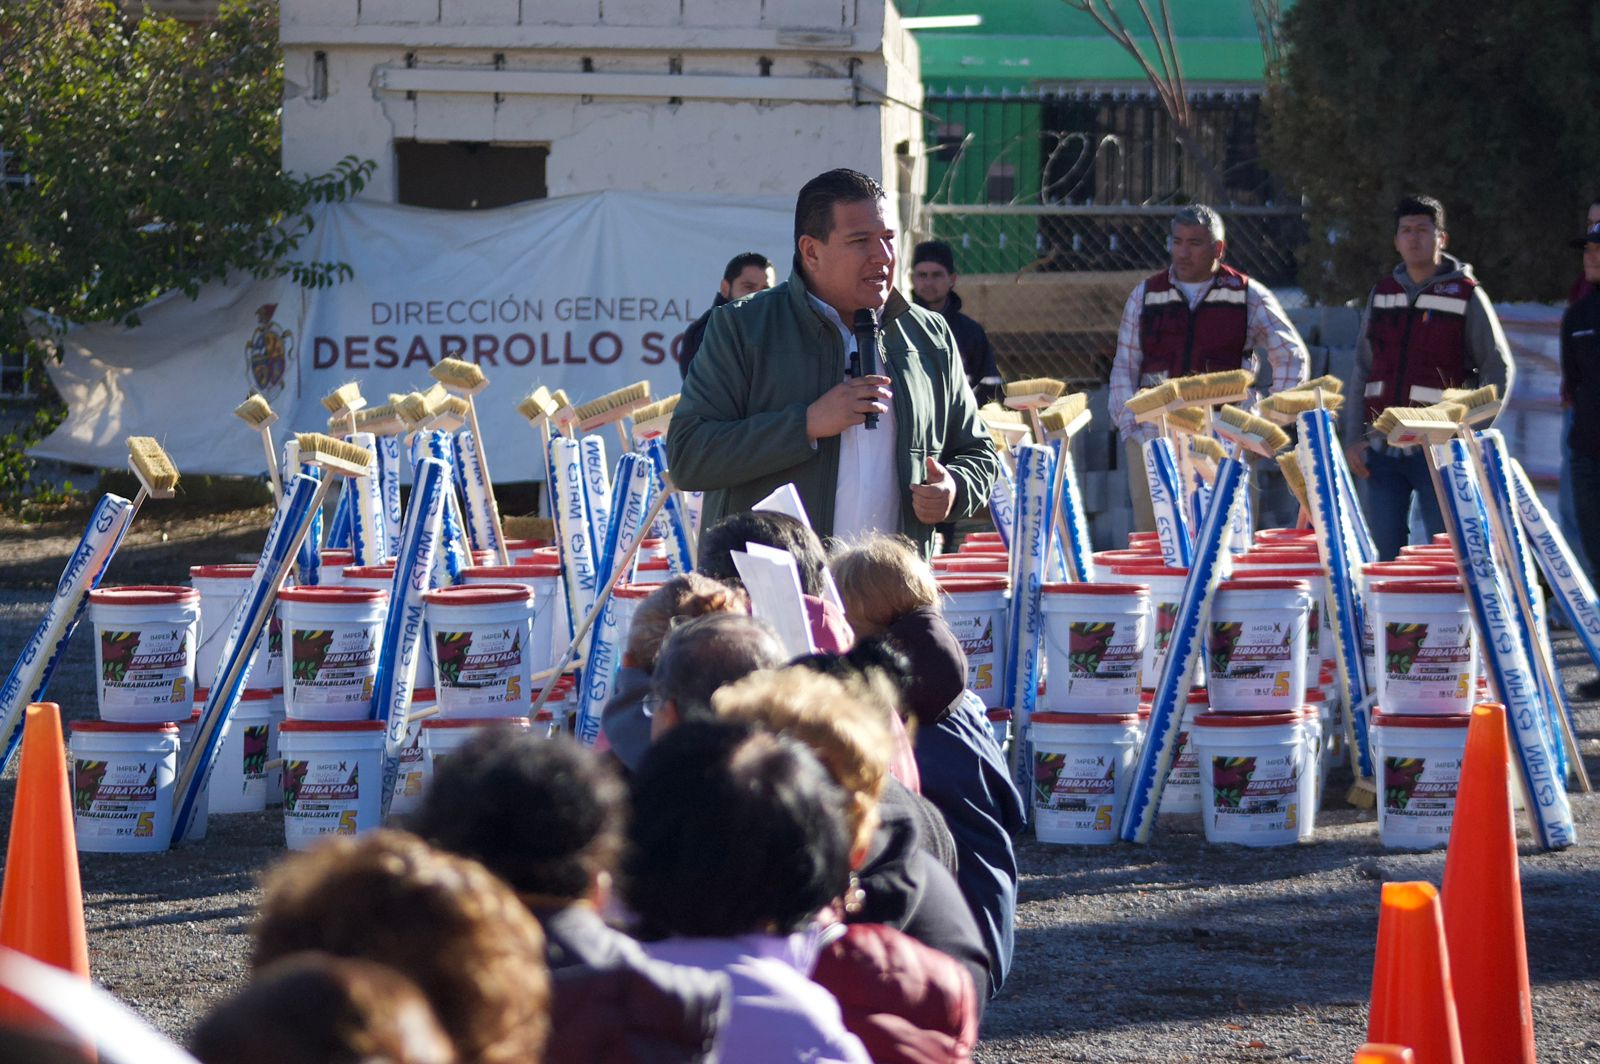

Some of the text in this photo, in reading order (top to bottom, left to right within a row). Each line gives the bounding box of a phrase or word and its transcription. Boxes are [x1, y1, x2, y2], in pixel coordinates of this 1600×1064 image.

[371, 294, 700, 325] DIRECCIÓN GENERAL
[313, 331, 623, 369] DESARROLLO
[586, 440, 604, 496] ESTAM
[568, 462, 582, 519] ESTAM
[620, 492, 642, 552] ESTAM
[1464, 518, 1489, 578] ESTAM
[1536, 530, 1570, 578] ESTAM
[412, 531, 432, 590] ESTAM
[571, 533, 594, 590] ESTAM
[1568, 588, 1600, 635] ESTAM
[1483, 593, 1512, 654] ESTAM
[401, 606, 422, 666] ESTAM
[131, 653, 186, 664] FIBRATADO
[324, 652, 375, 662] FIBRATADO
[464, 650, 520, 664] FIBRATADO
[1233, 646, 1290, 655] FIBRATADO
[1418, 648, 1470, 657] FIBRATADO
[590, 640, 612, 700] ESTAM
[976, 664, 992, 686] 5
[105, 680, 172, 688] IMPERMEABILIZANTE
[172, 677, 186, 699] 5
[295, 678, 364, 686] IMPERMEABILIZANTE
[506, 676, 520, 698] 5
[1274, 672, 1290, 692] 5
[1504, 668, 1534, 730] ESTAM
[390, 680, 408, 742] ESTAM
[1056, 778, 1113, 788] FIBRATADO
[1526, 744, 1554, 807] ESTAM
[98, 786, 156, 794] FIBRATADO
[300, 785, 357, 794] FIBRATADO
[1414, 783, 1458, 792] FIBRATA
[136, 812, 155, 833] 5
[338, 810, 358, 832] 5
[1096, 805, 1113, 826] 5
